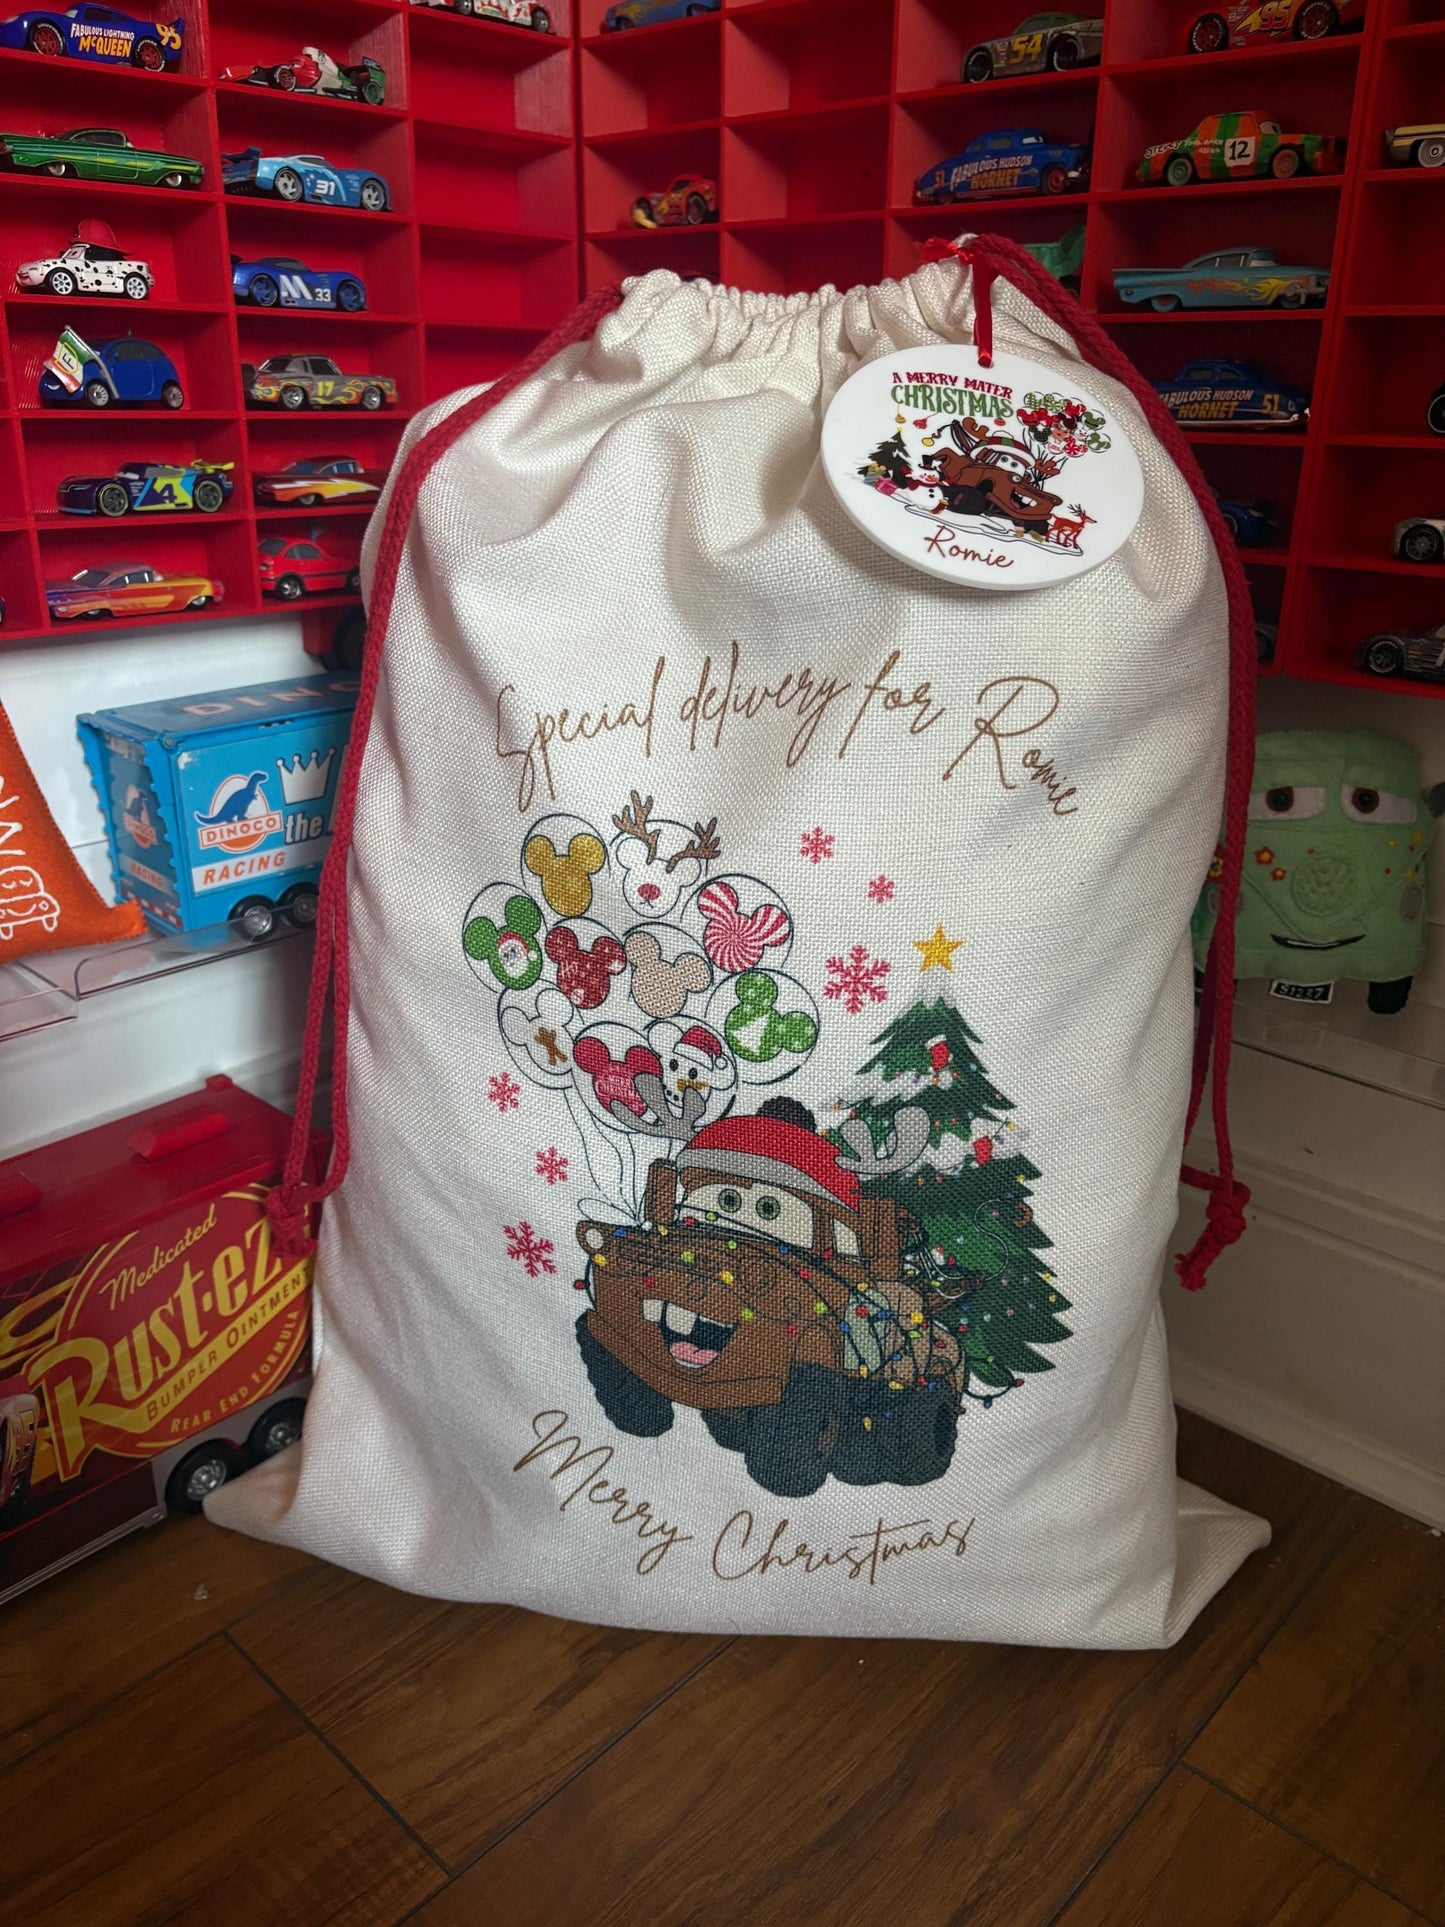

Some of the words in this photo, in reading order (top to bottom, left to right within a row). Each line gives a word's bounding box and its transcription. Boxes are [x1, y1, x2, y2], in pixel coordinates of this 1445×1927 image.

[1259, 1, 1291, 31] 95
[70, 23, 103, 38] FABULOUS
[103, 28, 135, 40] LIGHTNING
[155, 23, 182, 50] 95
[1008, 32, 1044, 64] 54
[1228, 140, 1251, 161] 12
[315, 179, 336, 196] 31
[314, 288, 332, 302] 33
[317, 381, 335, 397] 17
[892, 372, 903, 384] A
[906, 372, 959, 387] MERRY
[964, 377, 1014, 400] MATER
[1213, 390, 1254, 401] HUDSON
[891, 384, 1014, 418] CHRISTMAS
[1178, 401, 1240, 419] HORNET
[1262, 394, 1280, 415] 51
[160, 483, 178, 504] 4
[923, 525, 1015, 569] Romie
[497, 655, 666, 813] Special
[679, 640, 853, 769] delivery
[837, 650, 947, 760] for
[942, 676, 1079, 817] Romie
[205, 817, 277, 844] DINOCO
[285, 812, 323, 844] the
[203, 850, 286, 885] RACING
[99, 1202, 217, 1312] Medicated
[251, 1309, 300, 1384] FORMULA
[146, 1350, 218, 1423] BUMPER
[171, 1410, 212, 1434] REAR
[219, 1386, 250, 1413] END
[513, 1408, 693, 1576] Merry
[712, 1510, 976, 1586] Christmas
